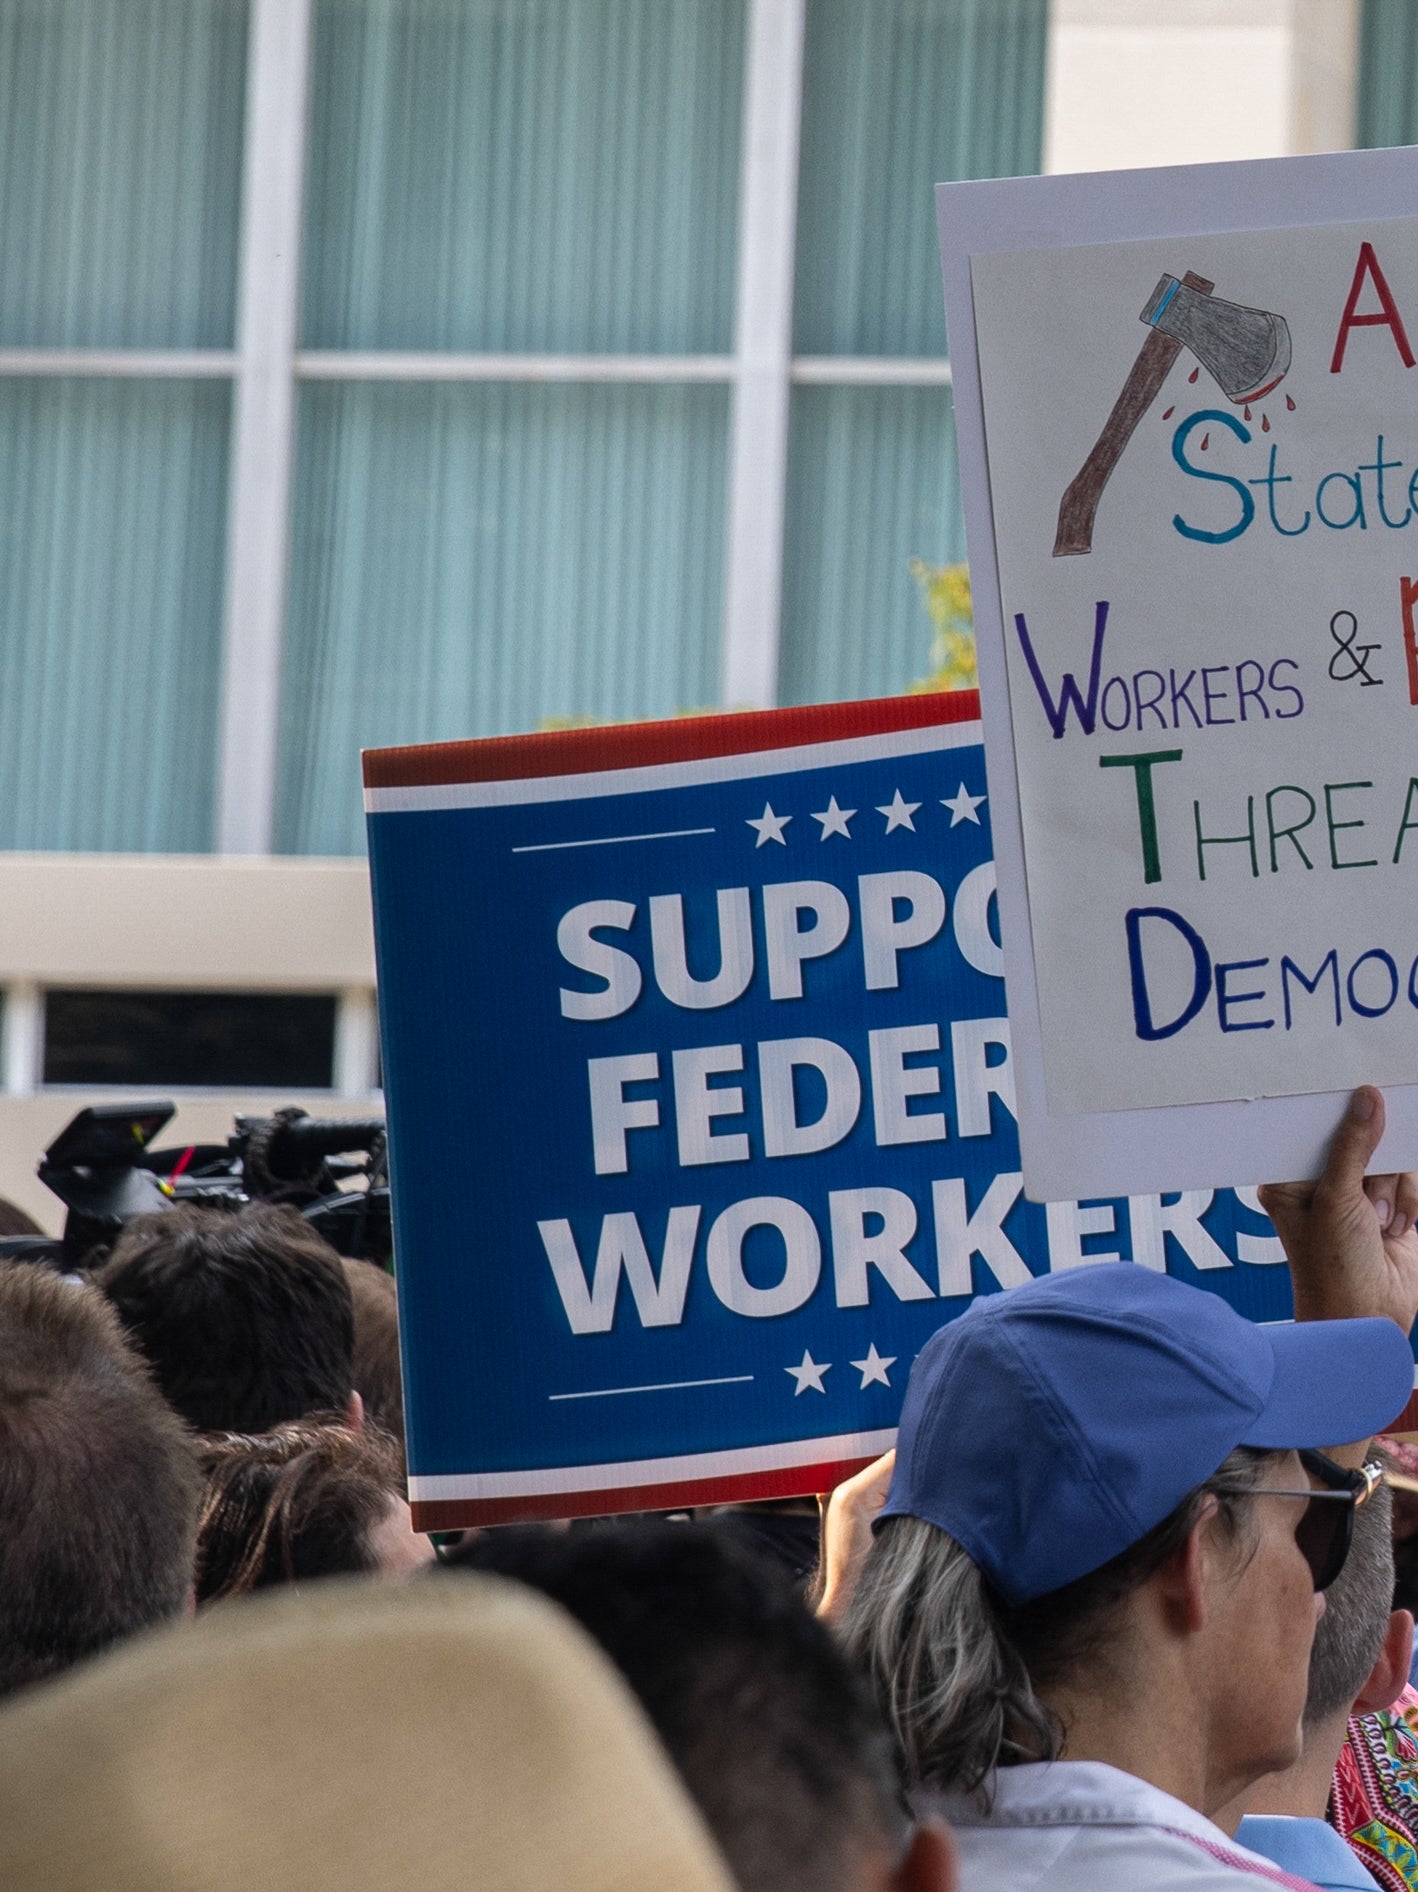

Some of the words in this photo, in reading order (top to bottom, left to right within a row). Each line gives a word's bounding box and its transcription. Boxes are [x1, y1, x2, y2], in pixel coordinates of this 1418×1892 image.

[1014, 600, 1305, 740] WORKERS
[1328, 610, 1384, 687] &
[556, 860, 1004, 1022] SUPP
